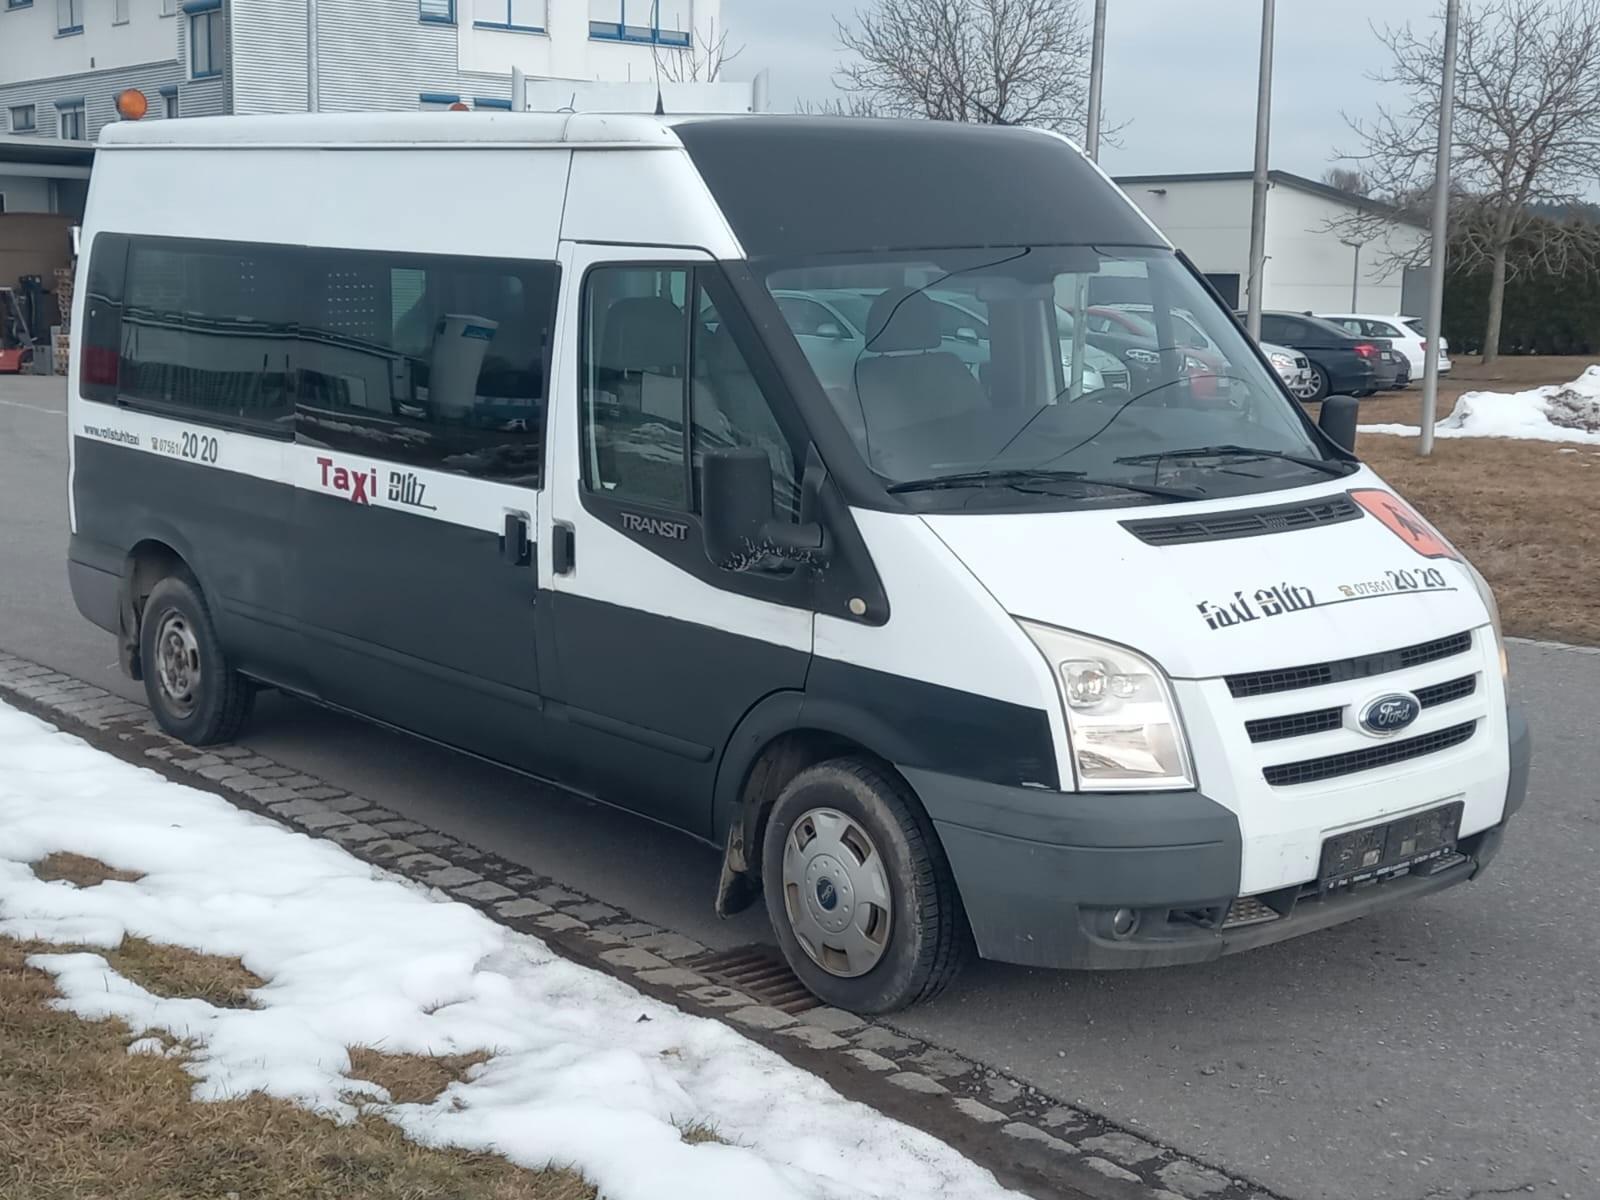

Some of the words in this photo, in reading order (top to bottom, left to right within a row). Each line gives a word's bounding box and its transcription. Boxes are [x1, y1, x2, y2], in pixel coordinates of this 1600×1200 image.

[317, 456, 377, 505] Taxi
[620, 511, 689, 540] TRANSIT
[1378, 701, 1411, 726] Ford
